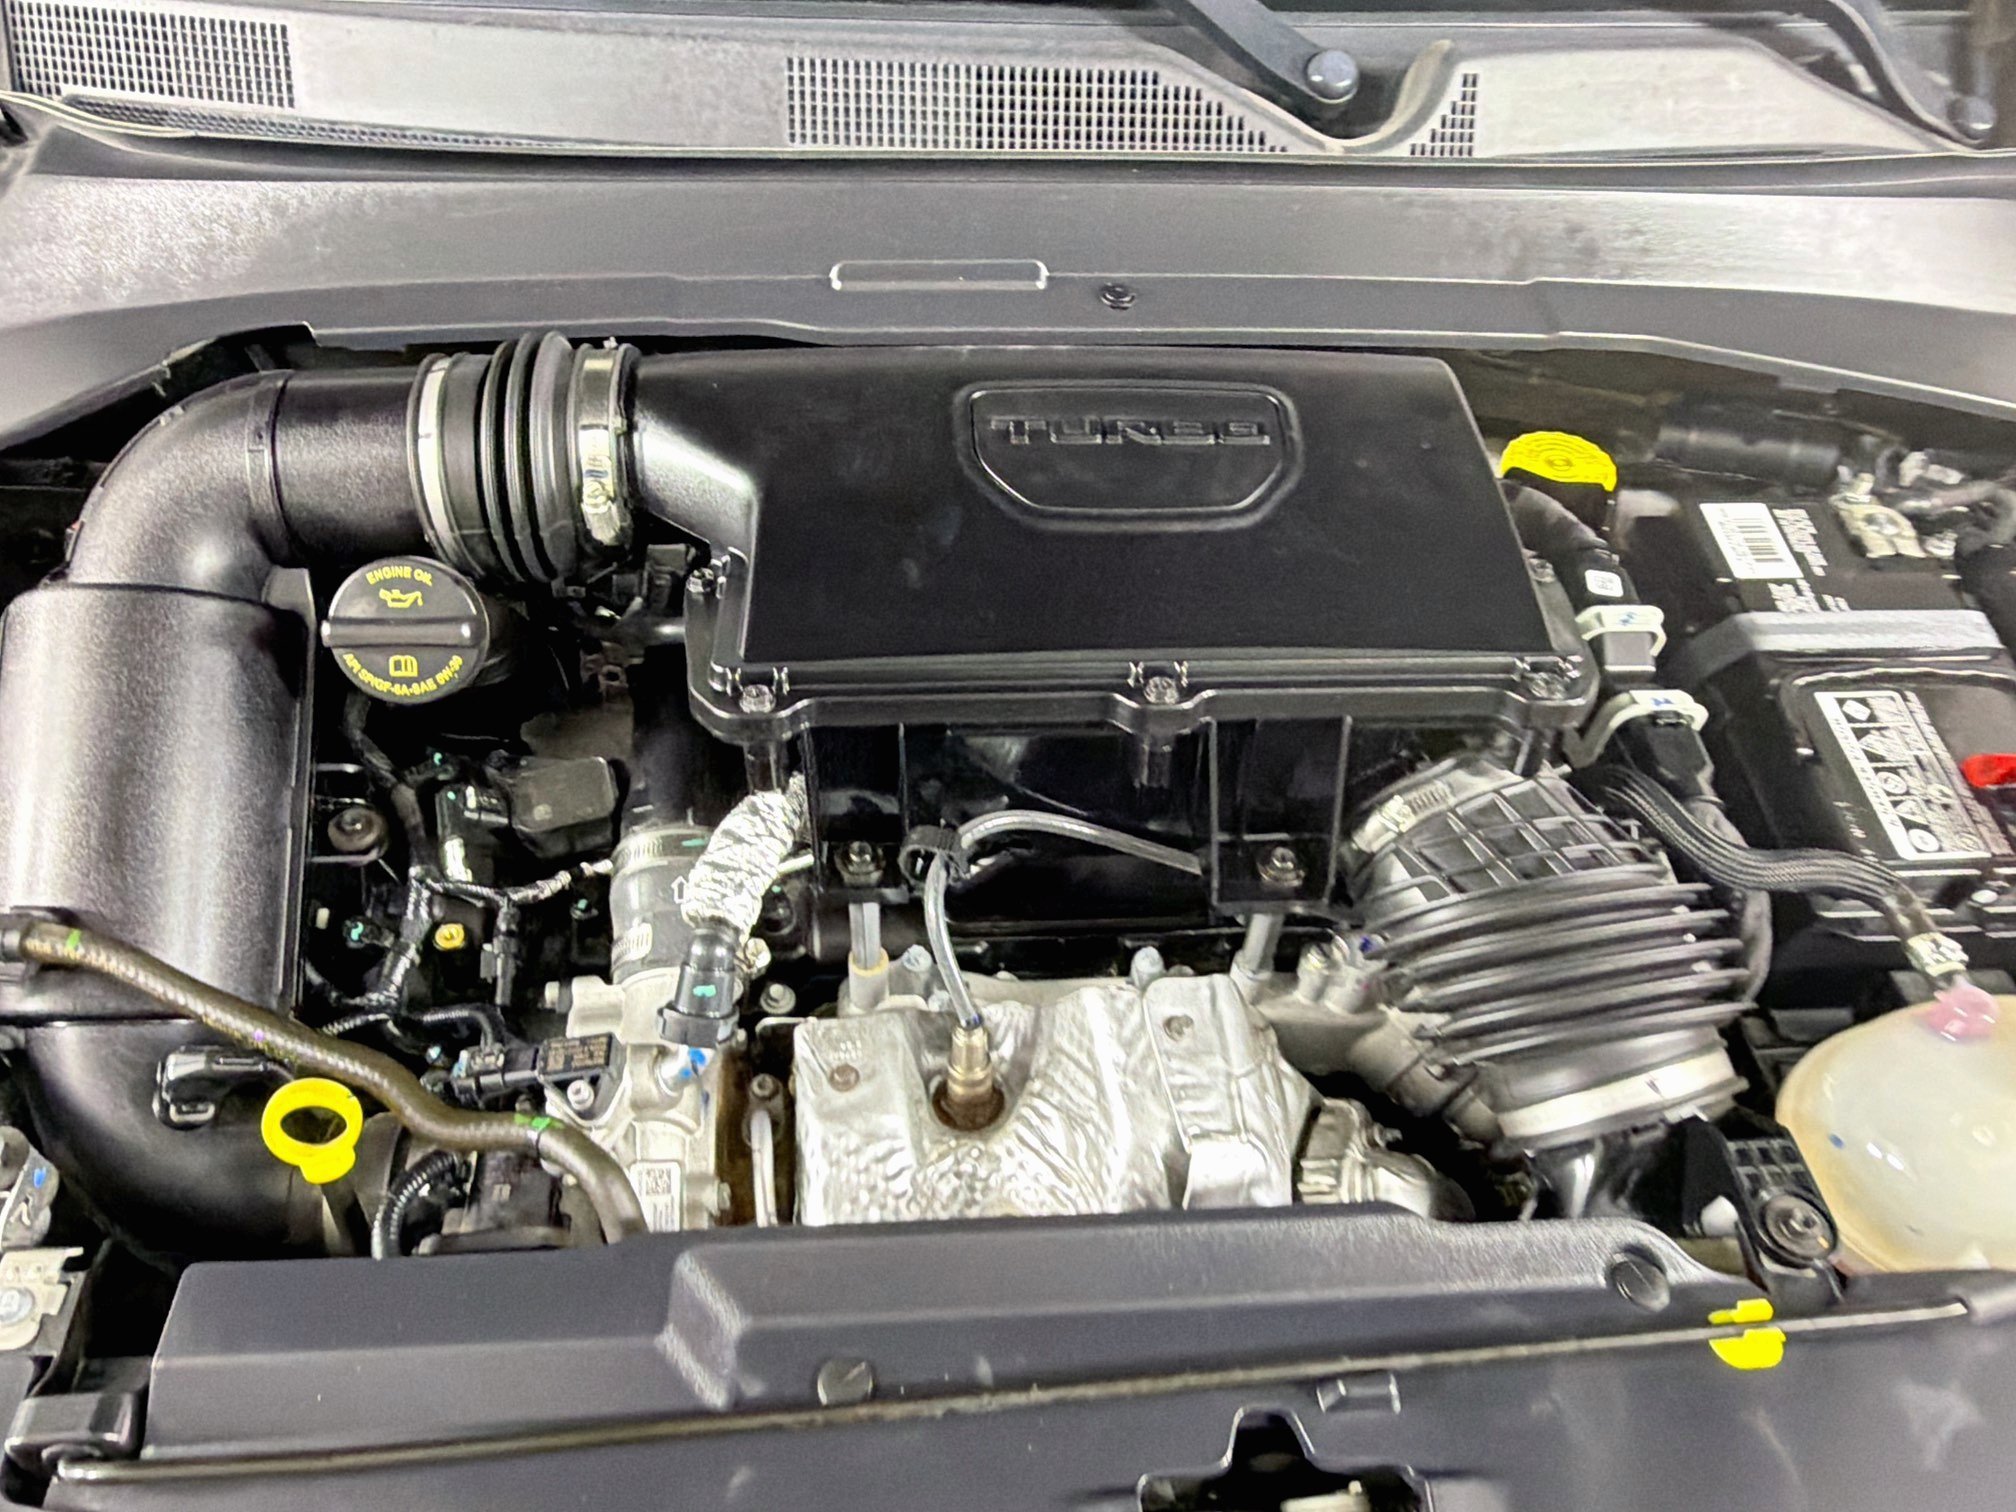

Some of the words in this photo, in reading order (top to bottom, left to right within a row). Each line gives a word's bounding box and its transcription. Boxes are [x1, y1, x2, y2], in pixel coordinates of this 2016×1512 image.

[990, 415, 1271, 445] TURBO
[365, 565, 413, 585] ENGINE
[413, 568, 433, 587] OIL
[342, 653, 362, 674] API
